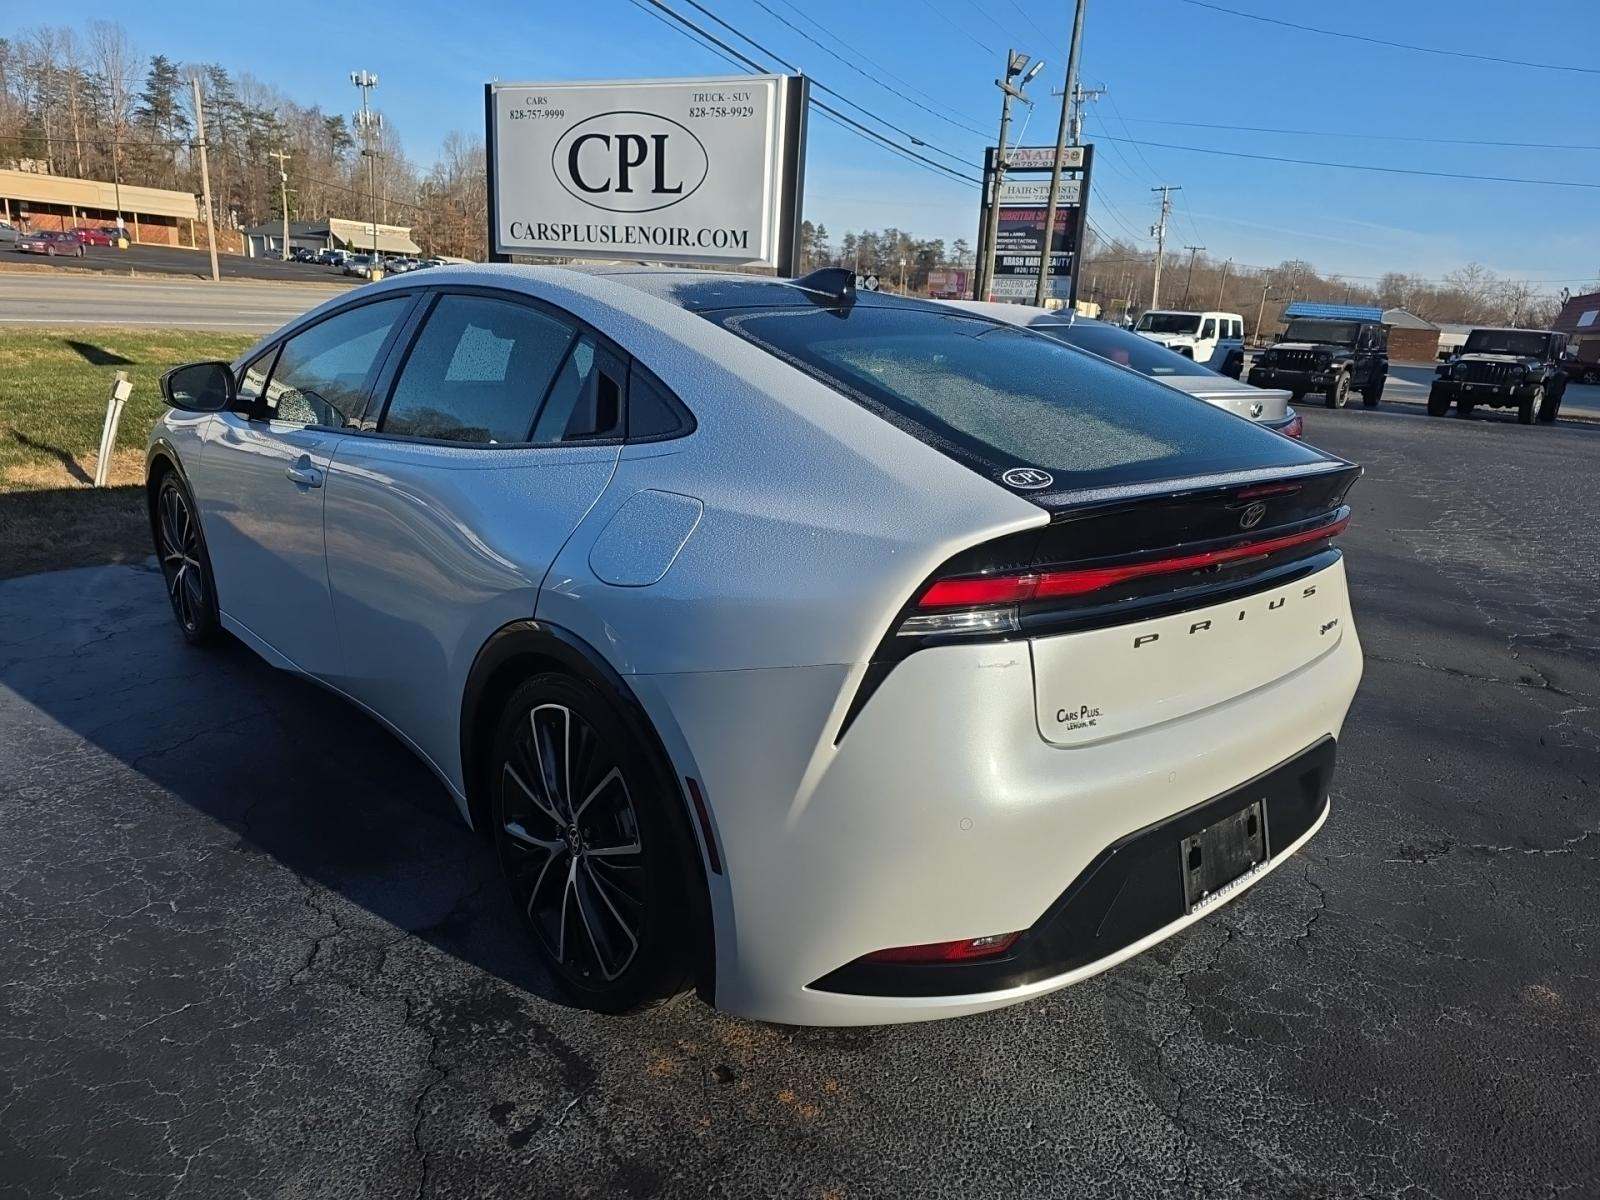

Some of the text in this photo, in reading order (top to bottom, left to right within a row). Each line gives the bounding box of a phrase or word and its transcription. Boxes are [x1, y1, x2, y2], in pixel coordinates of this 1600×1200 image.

[526, 96, 548, 106] CARS
[692, 92, 725, 102] TRUCK
[732, 92, 752, 102] SUV
[509, 109, 565, 120] 828-757-9999
[689, 106, 754, 118] 828-758-9929
[567, 133, 684, 194] CPL
[1008, 185, 1079, 194] HAIRSTYISTS
[509, 221, 749, 250] CARSPLUSLENOIR.COM
[1047, 257, 1071, 268] EAUTY
[1007, 470, 1049, 485] CPL
[1133, 585, 1316, 648] PRIUS
